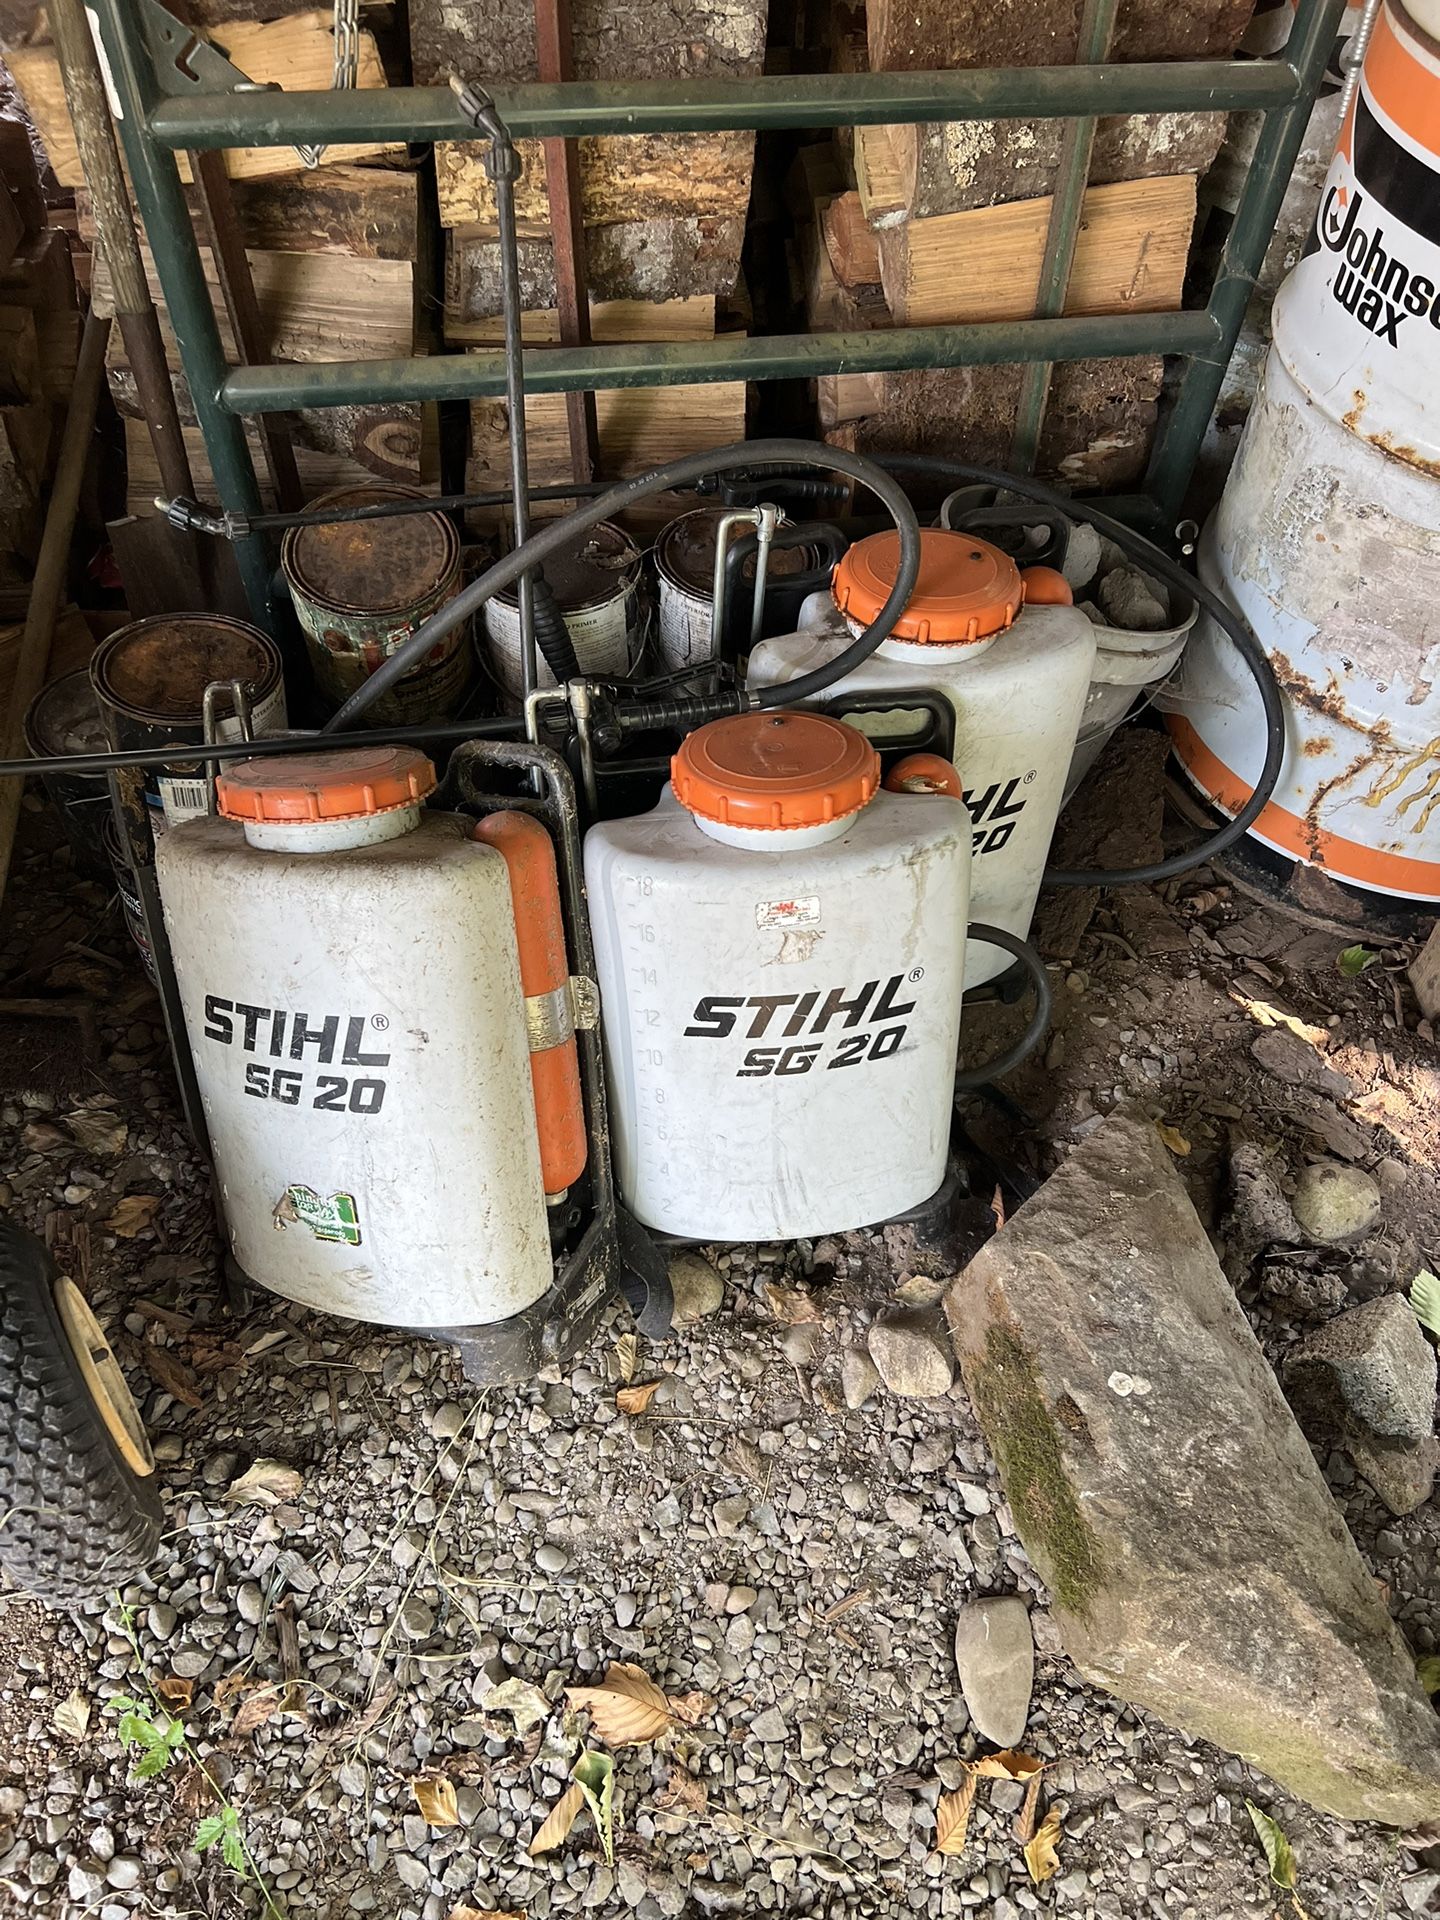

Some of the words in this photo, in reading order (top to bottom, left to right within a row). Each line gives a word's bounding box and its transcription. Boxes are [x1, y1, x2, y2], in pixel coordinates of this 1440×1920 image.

[1333, 262, 1408, 349] wax
[571, 619, 598, 629] PRIMER
[736, 1043, 823, 1077] SG
[827, 1025, 907, 1070] 20
[244, 1062, 303, 1106] SG
[313, 1075, 386, 1114] 20
